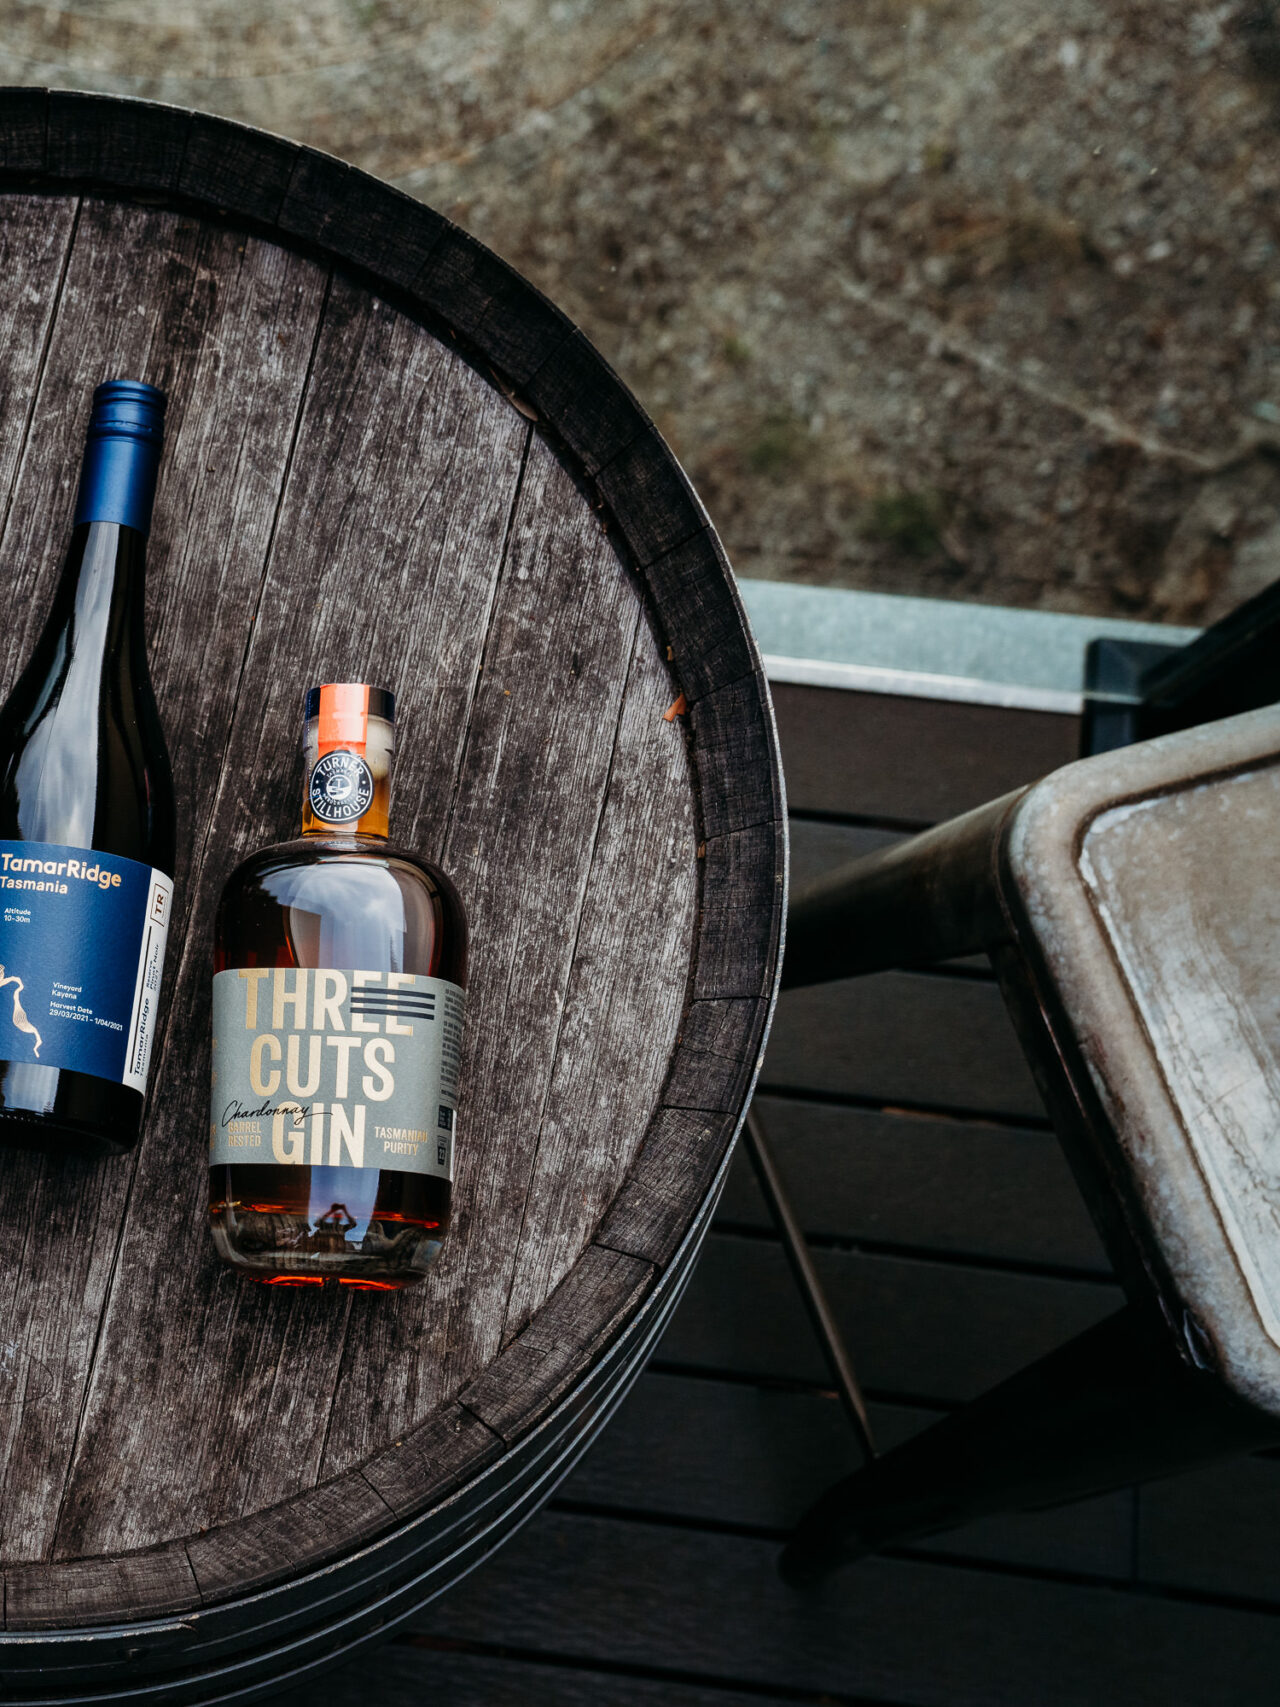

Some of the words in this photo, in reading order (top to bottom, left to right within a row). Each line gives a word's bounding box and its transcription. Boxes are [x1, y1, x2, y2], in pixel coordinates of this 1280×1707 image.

[317, 756, 364, 777] TURNER
[312, 788, 369, 818] STILLHOUSE
[1, 853, 122, 890] TamarRidge
[0, 876, 68, 894] Tasmania
[4, 907, 31, 916] Altitude
[154, 893, 164, 914] TR
[52, 982, 82, 993] Vineyard
[50, 1001, 76, 1012] Harvest
[77, 1005, 93, 1015] Date
[238, 968, 415, 1037] THREE
[49, 1008, 89, 1023] 29/03/2021
[134, 998, 150, 1075] TamarRidge
[250, 1034, 396, 1102] CUTS
[221, 1099, 333, 1128] Chardonnay
[228, 1121, 262, 1133] BARREL
[272, 1100, 366, 1168] GIN
[374, 1126, 428, 1143] TASMANIAN
[228, 1134, 261, 1147] RESTED
[383, 1141, 418, 1156] PURITY
